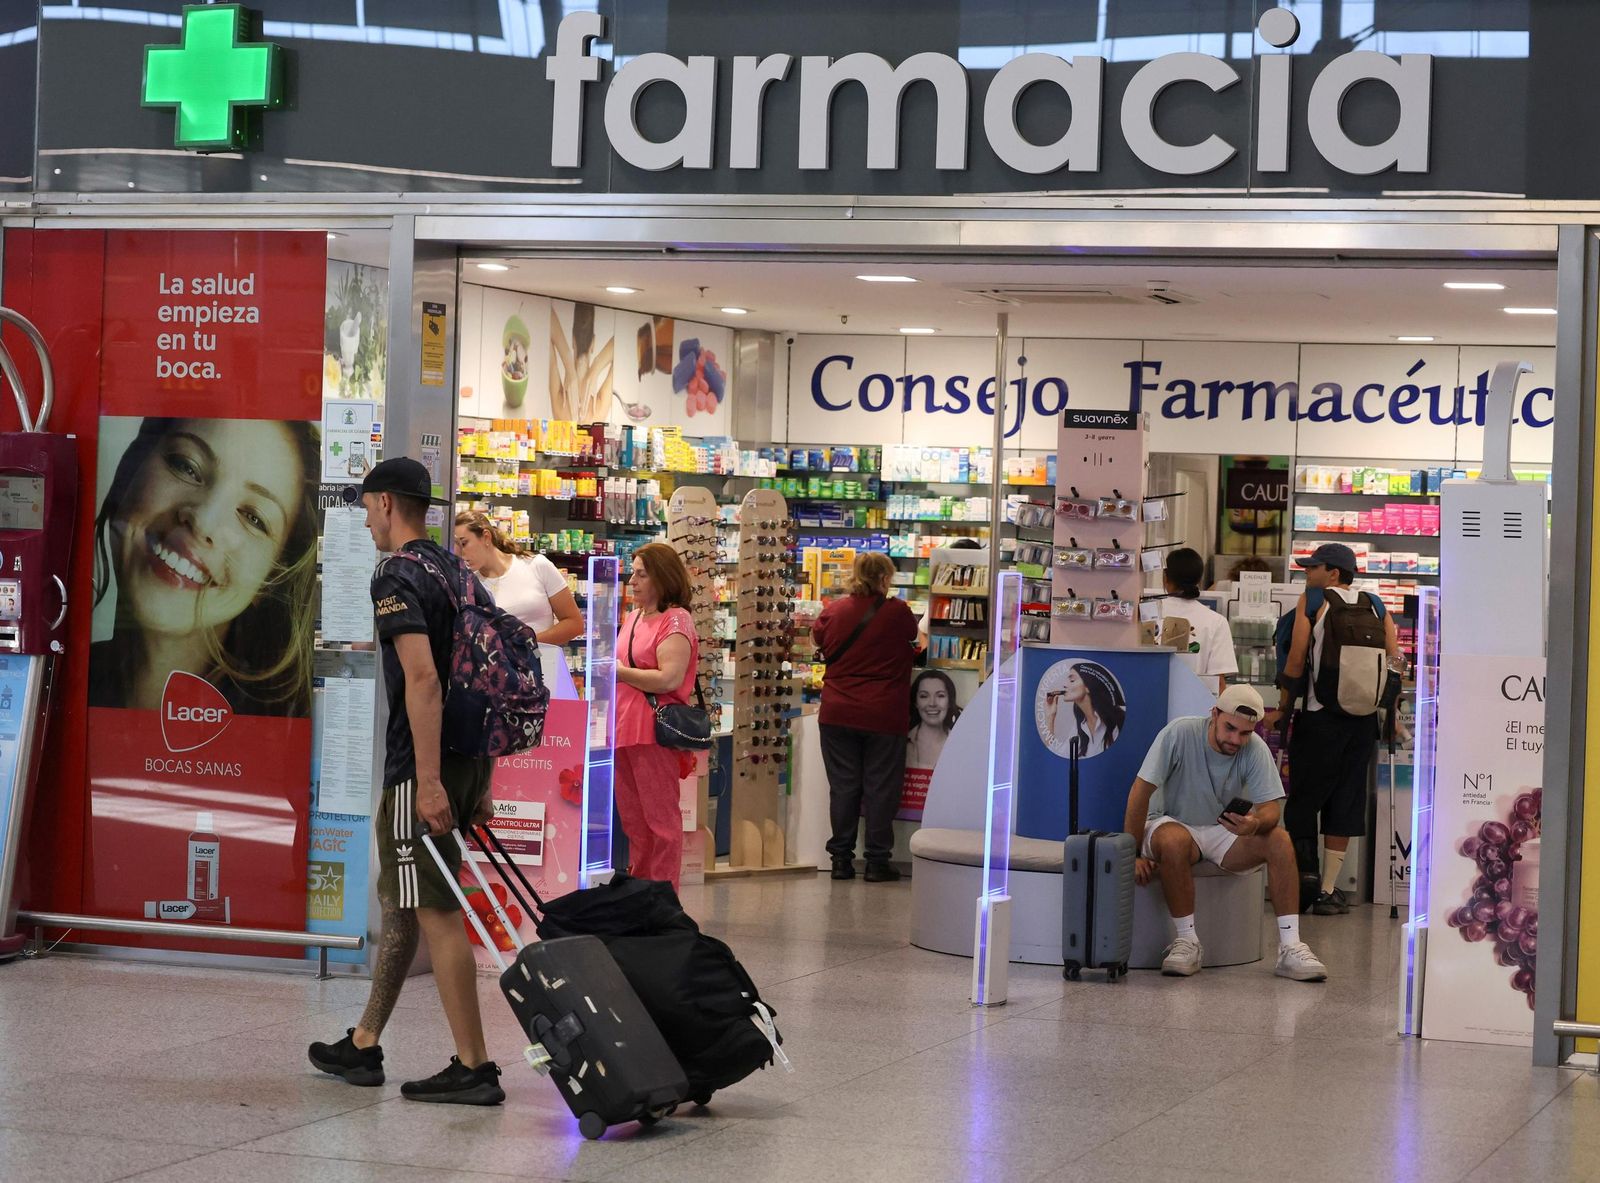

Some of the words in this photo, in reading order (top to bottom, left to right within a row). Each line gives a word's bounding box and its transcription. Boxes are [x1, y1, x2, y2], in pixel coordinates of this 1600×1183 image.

[546, 8, 1433, 175] farmacia
[159, 273, 184, 295] La
[191, 273, 255, 295] salud
[157, 300, 259, 327] empieza
[157, 332, 187, 350] en
[193, 330, 217, 351] tu
[156, 356, 222, 380] boca.
[811, 354, 1070, 438] Consejo
[1123, 359, 1554, 429] Farmacéutc
[1241, 483, 1289, 502] CAUD
[375, 602, 408, 616] WANDA
[376, 595, 397, 608] VISIT
[1501, 674, 1546, 702] CA
[167, 701, 229, 724] Lacer
[1505, 720, 1521, 734] ¿El
[1506, 738, 1517, 751] El
[1522, 739, 1545, 754] tuy
[145, 759, 192, 775] BOCAS
[196, 761, 242, 777] SANAS
[497, 757, 510, 768] LA
[512, 758, 553, 770] CISTITIS
[499, 803, 517, 813] Arko
[195, 846, 215, 854] Lacer
[162, 904, 189, 913] Lacer
[309, 895, 341, 907] AILY
